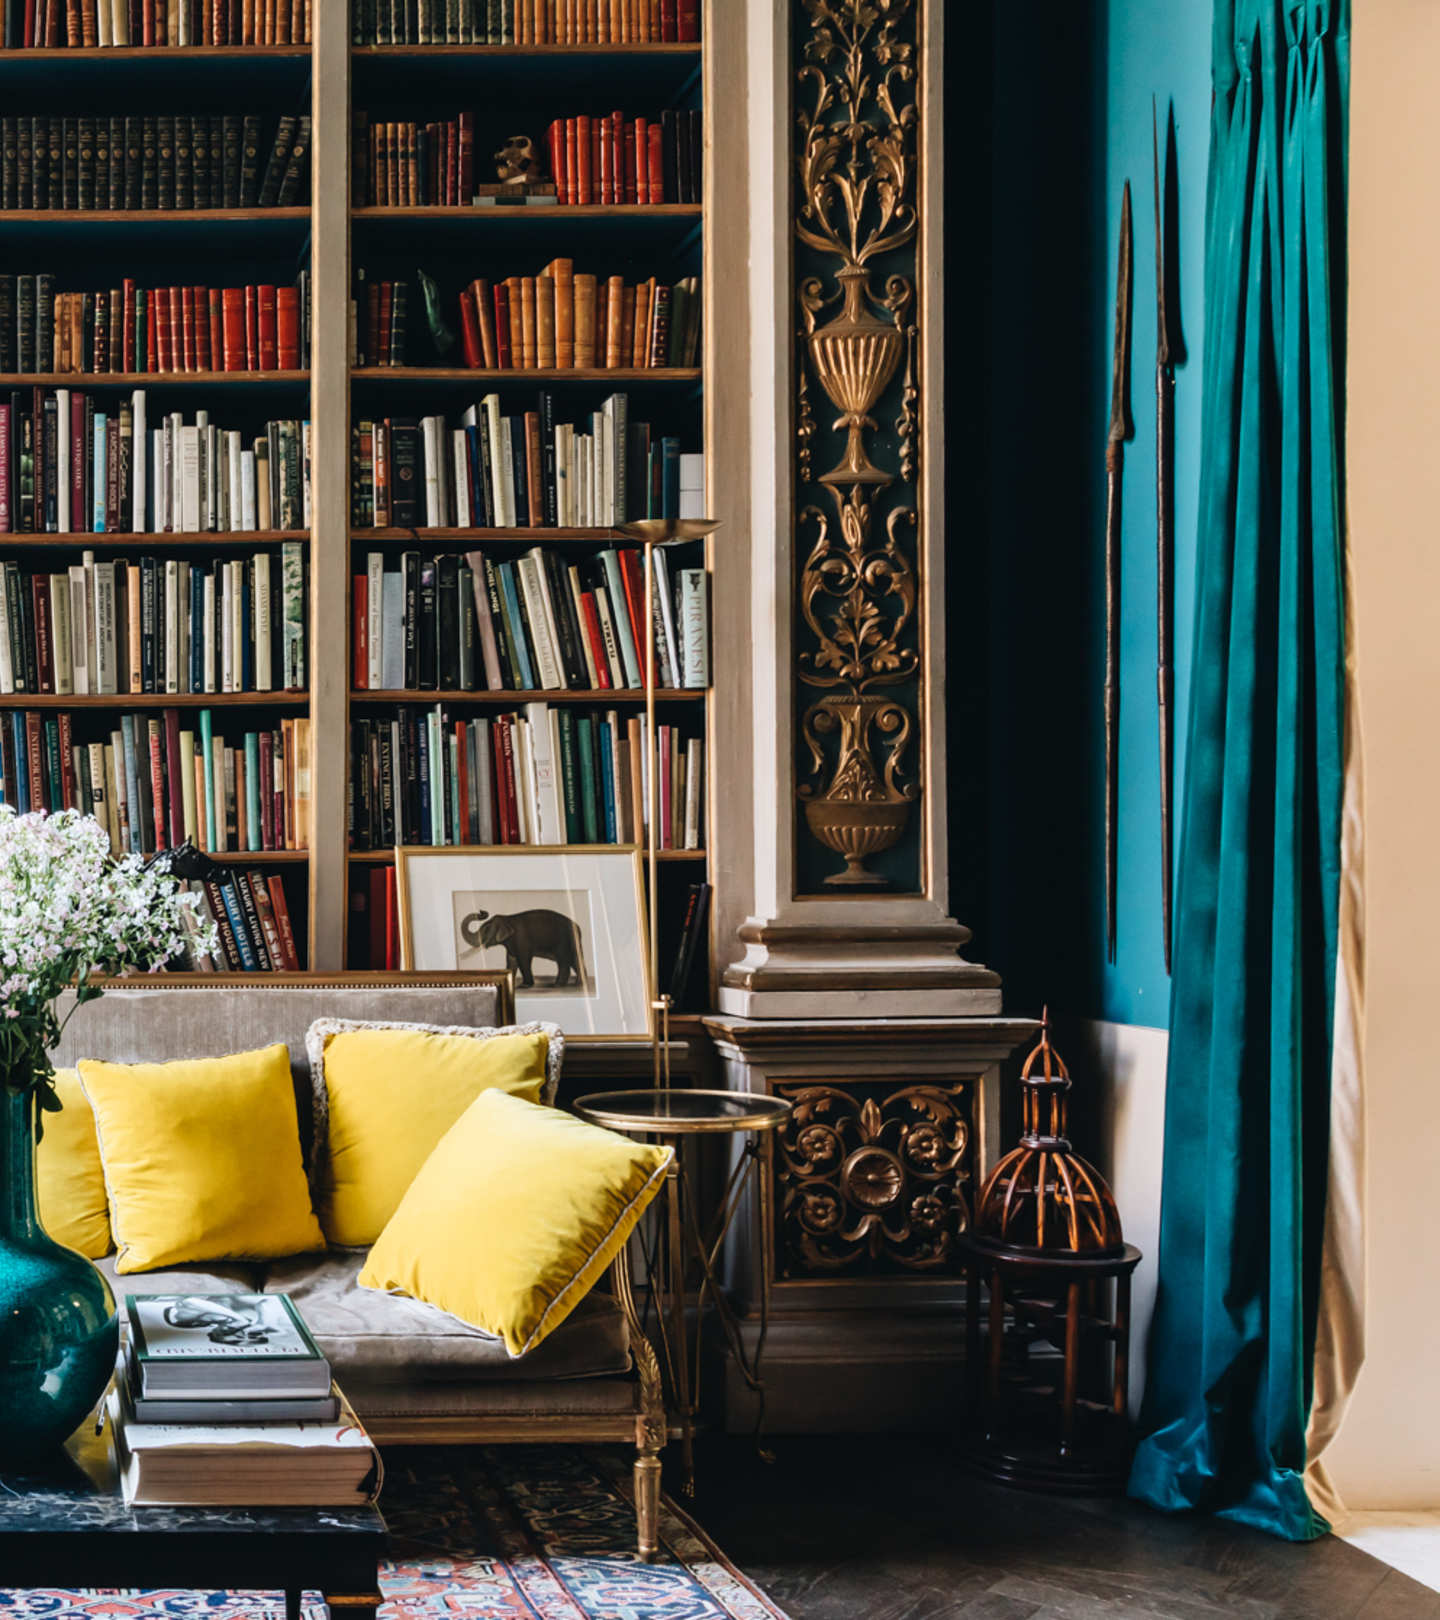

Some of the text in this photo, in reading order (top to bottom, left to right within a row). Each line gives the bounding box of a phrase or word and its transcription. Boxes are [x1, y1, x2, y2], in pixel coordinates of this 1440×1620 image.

[74, 437, 83, 489] ANTIQUAIRES
[689, 594, 704, 675] PIRANESI
[31, 731, 41, 773] INTERIOR
[380, 741, 393, 810] EXTINCT BIRDS
[502, 720, 512, 756] POUSSIN
[209, 881, 241, 965] UXURY HOUSES
[223, 883, 255, 968] UXURY HOTELS
[238, 876, 271, 971] LUXURY LIVING NEW
